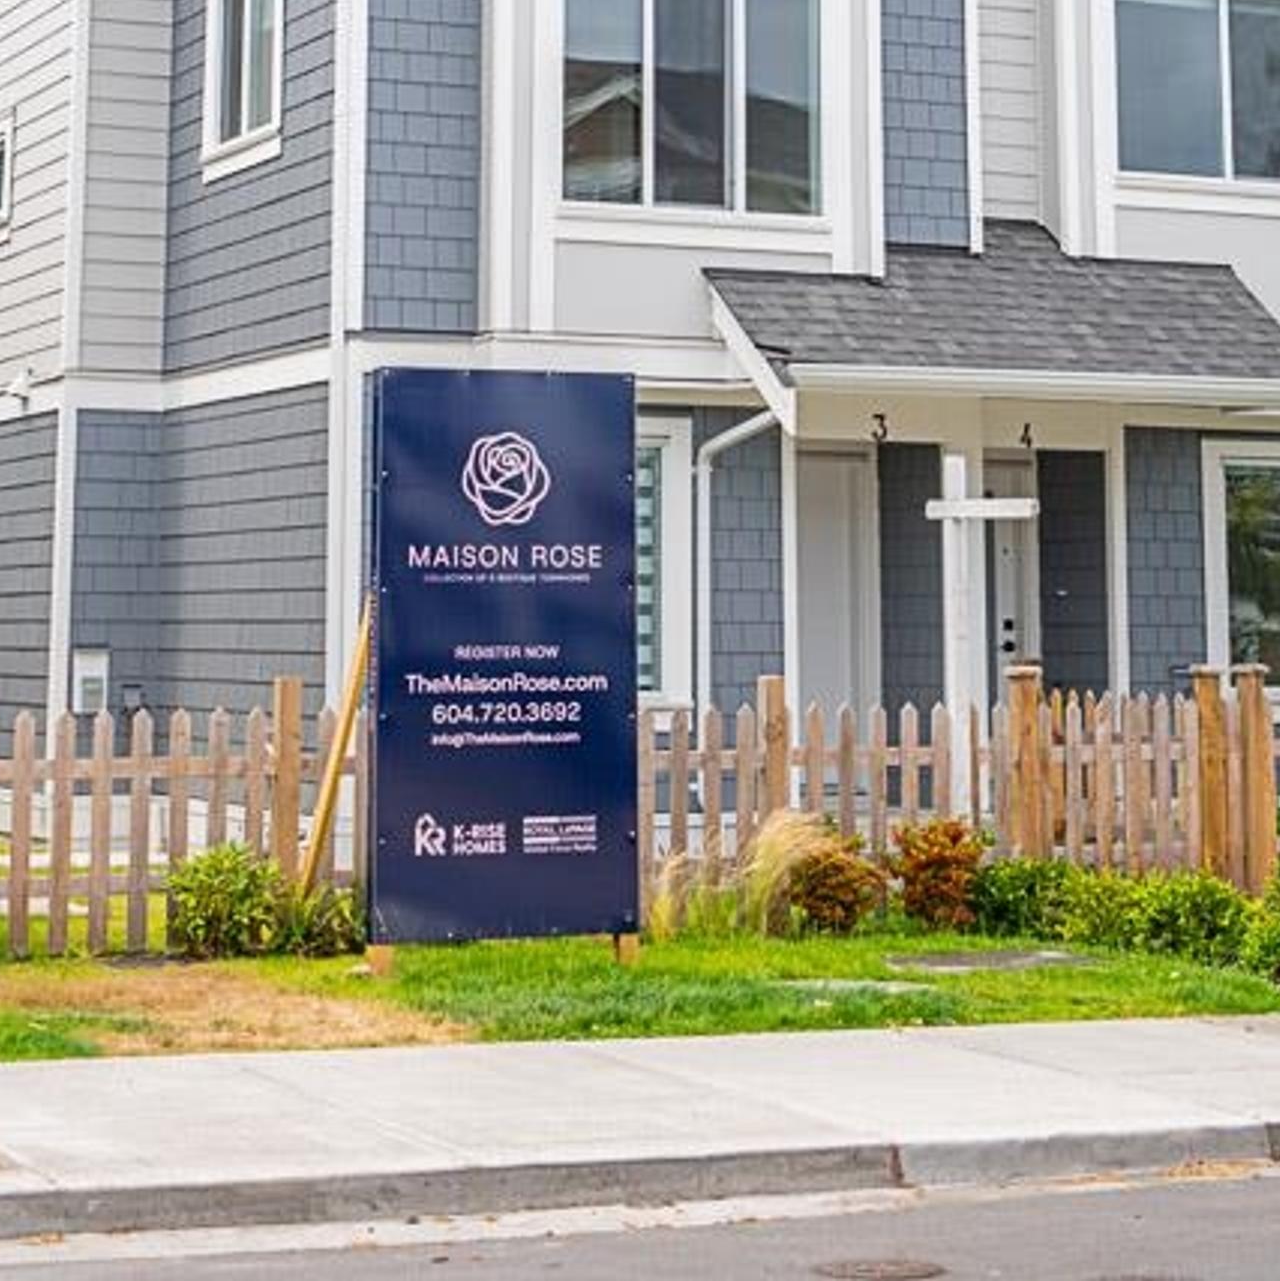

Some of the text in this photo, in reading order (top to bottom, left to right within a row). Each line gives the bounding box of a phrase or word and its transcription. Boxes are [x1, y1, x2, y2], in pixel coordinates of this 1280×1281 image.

[871, 413, 888, 440] 3
[1020, 422, 1032, 448] 4
[408, 544, 602, 568] MAISON ROSE
[453, 644, 560, 660] REGISTER NOW
[406, 672, 608, 695] TheMaisonRose.com
[453, 839, 506, 855] HOMES
